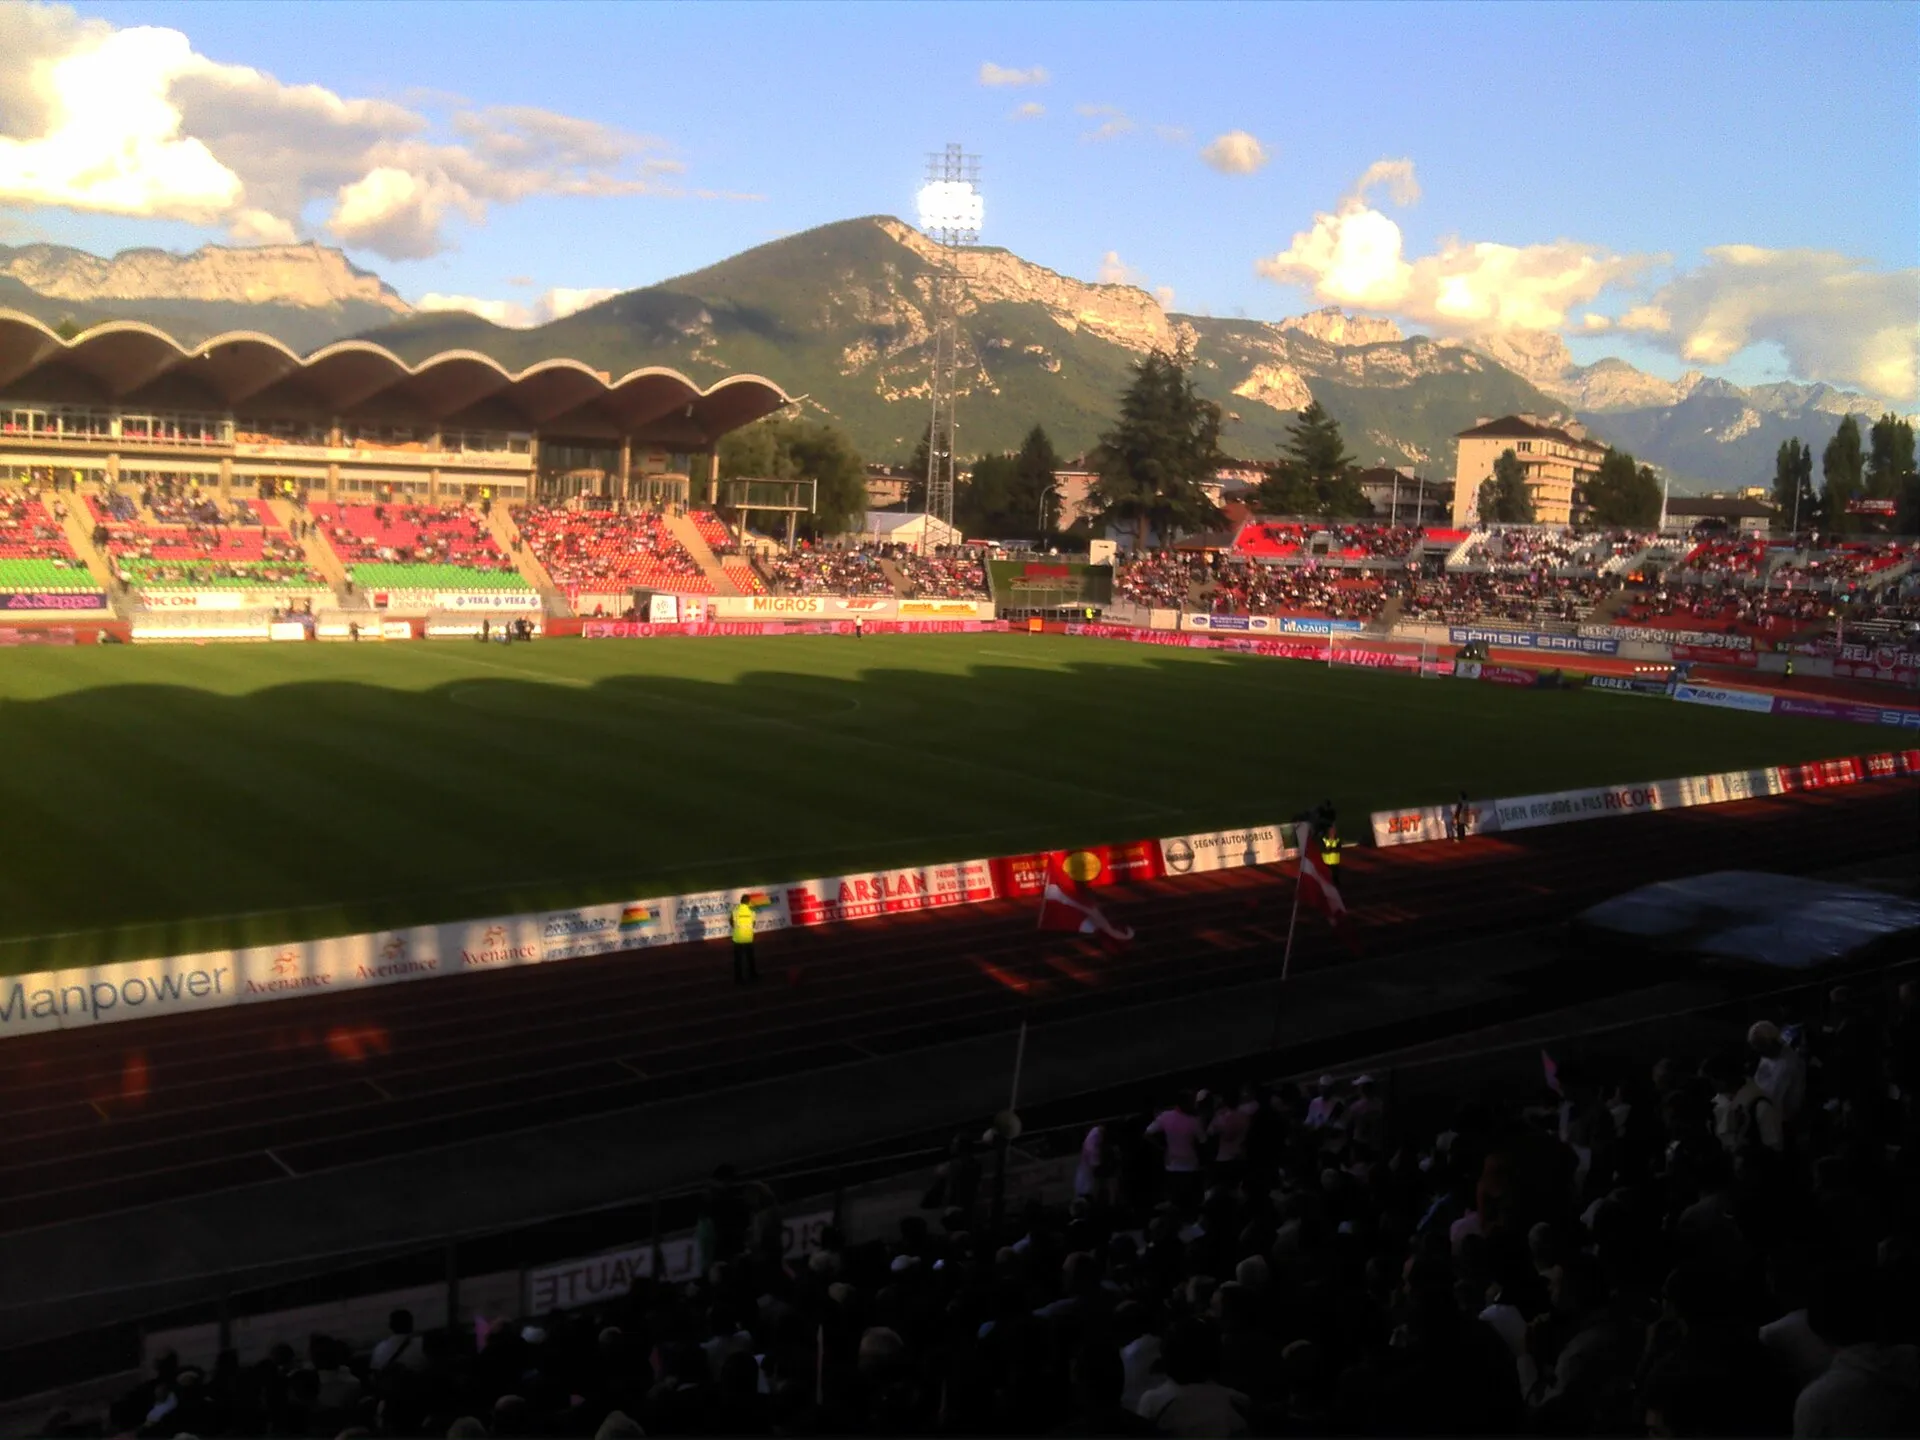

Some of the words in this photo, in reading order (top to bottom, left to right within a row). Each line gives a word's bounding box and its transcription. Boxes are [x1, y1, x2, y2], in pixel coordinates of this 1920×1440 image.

[467, 594, 490, 605] VEKA
[504, 594, 526, 605] VEKA
[752, 598, 818, 612] MIGROS
[696, 622, 764, 636] MAURIN
[908, 621, 965, 634] MAURIN
[1139, 630, 1192, 647] MAURIN
[1453, 630, 1531, 645] SAMSIC
[1536, 635, 1615, 652] SAMSIC
[1591, 676, 1634, 690] EUREX
[1603, 788, 1657, 810] RICOH
[1193, 837, 1220, 849] SEGNY
[1220, 831, 1274, 846] AUTOMOBILES
[838, 871, 928, 903] ARSLAN
[461, 944, 536, 966] Avenance
[356, 957, 438, 981] Avenance
[245, 971, 331, 996] Avenance
